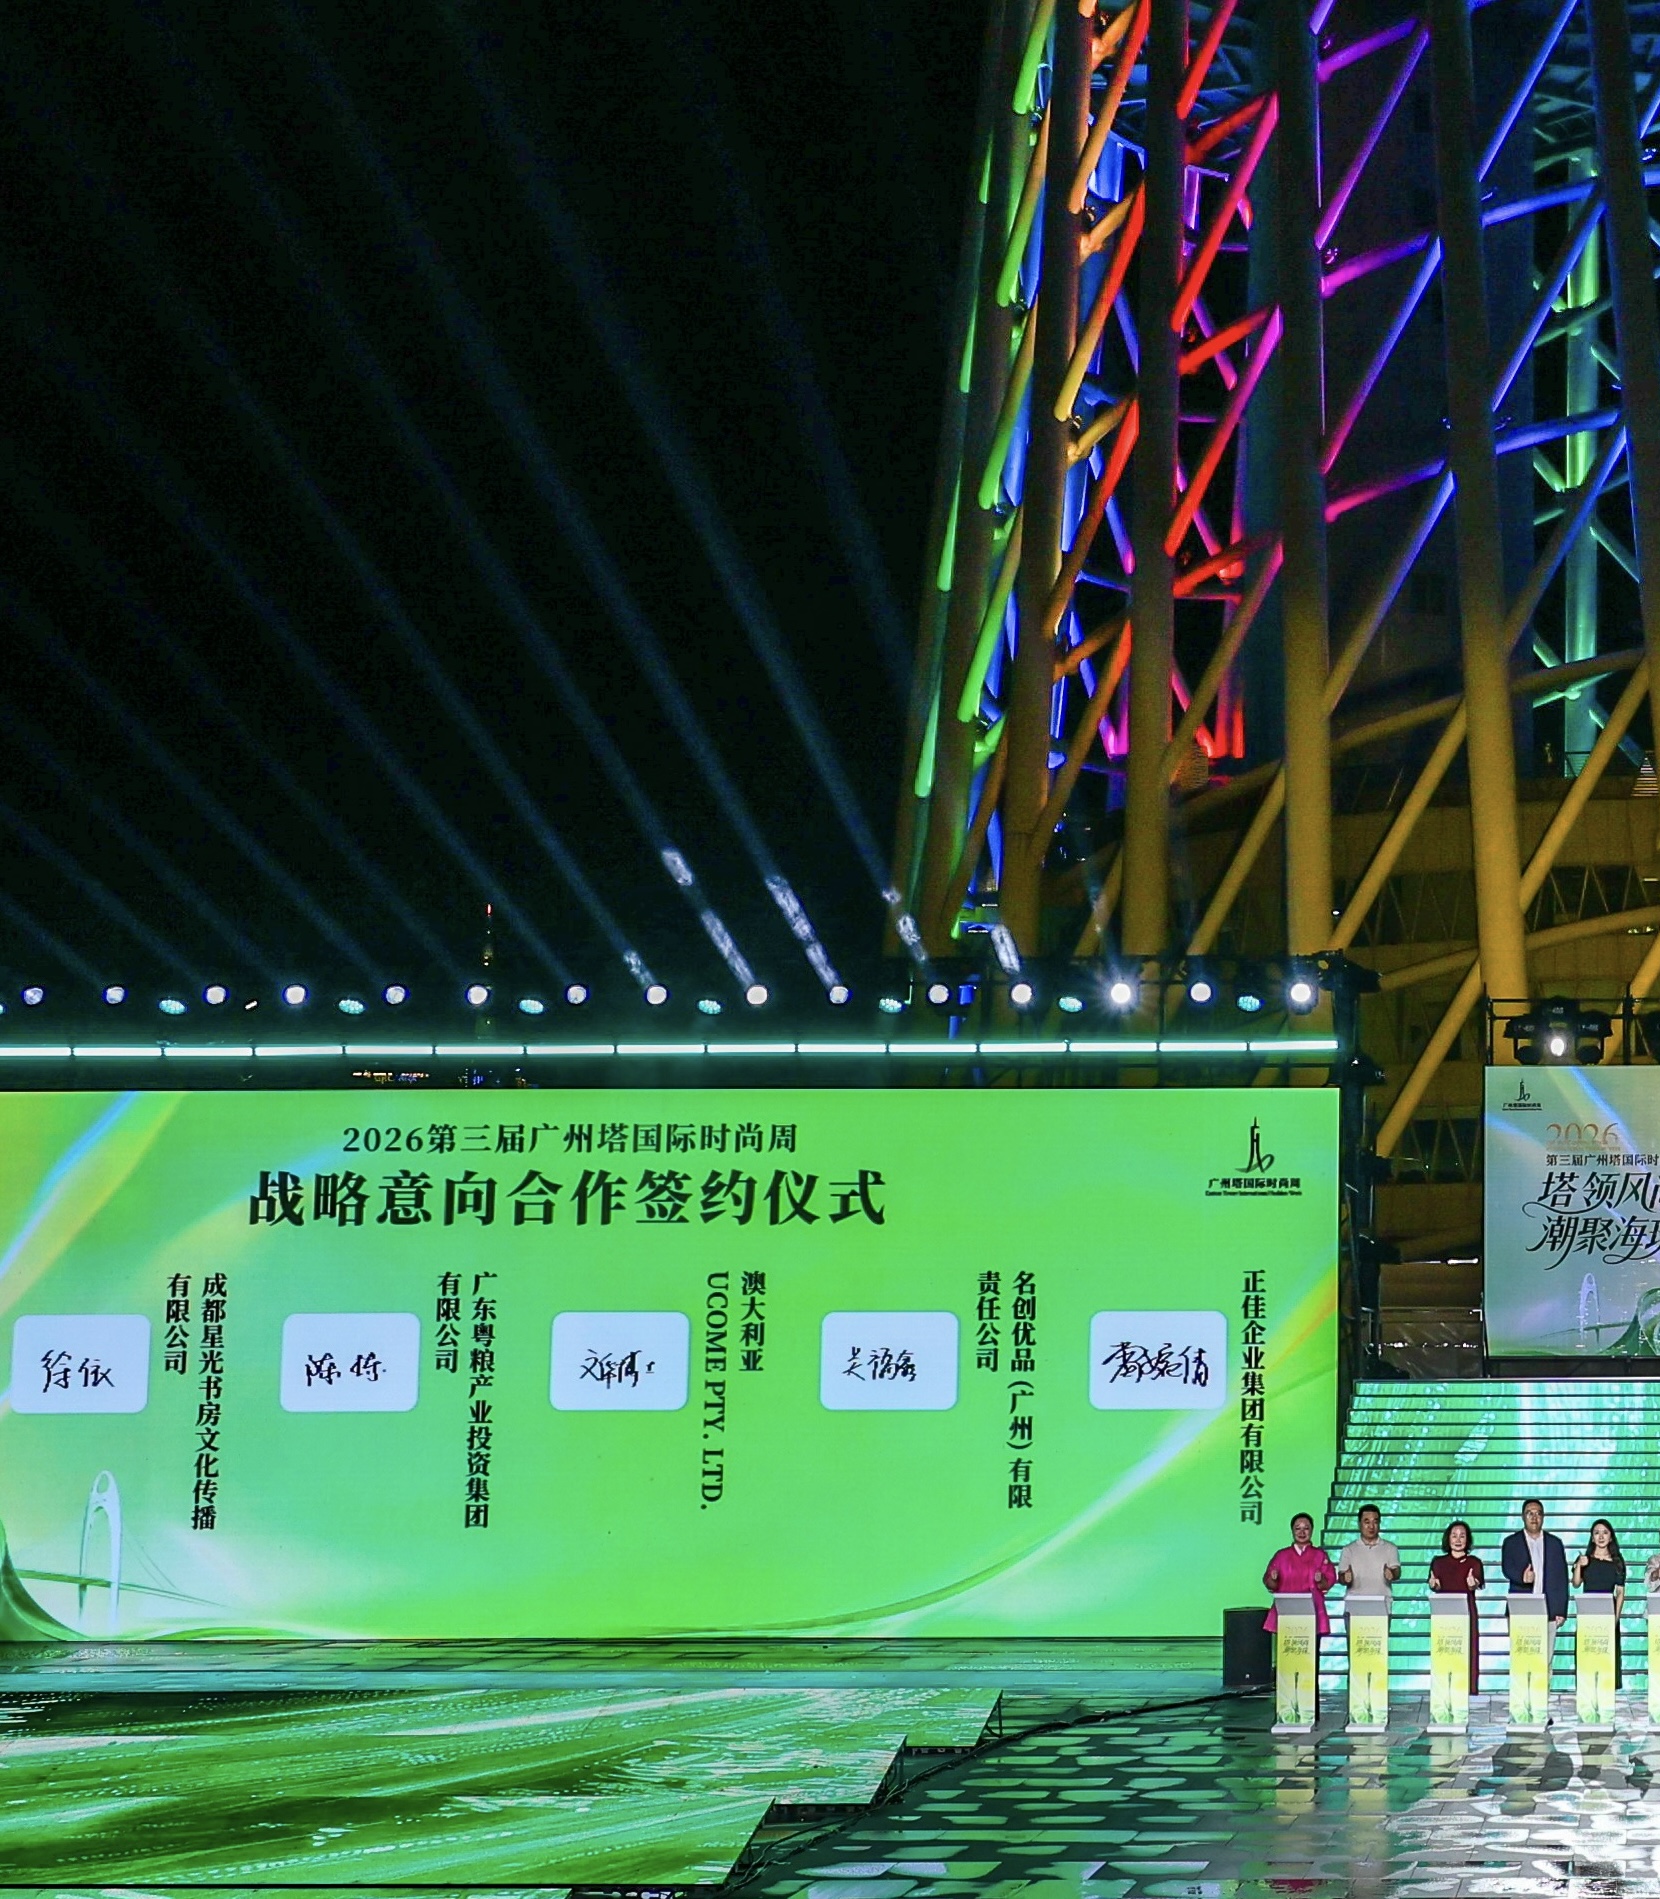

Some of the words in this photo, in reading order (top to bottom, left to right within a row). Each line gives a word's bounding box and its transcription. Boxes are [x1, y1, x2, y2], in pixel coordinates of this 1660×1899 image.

[342, 1122, 797, 1154] 2026第三届广州塔国际时尚周
[249, 1169, 886, 1227] 战略意向合作签约仪式
[164, 1272, 192, 1376] 有限公司
[435, 1271, 462, 1374] 有限公司
[704, 1271, 729, 1373] UCOME
[739, 1270, 767, 1372] 澳大利亚
[976, 1270, 1001, 1373] 责任公司
[191, 1272, 228, 1531] 成都星光书房文化传播
[464, 1271, 498, 1529] 广东粤粮产业投资集团
[702, 1380, 726, 1440] PTY.
[1240, 1269, 1266, 1526] 正佳企业集团有限公司
[700, 1448, 724, 1510] LTD.
